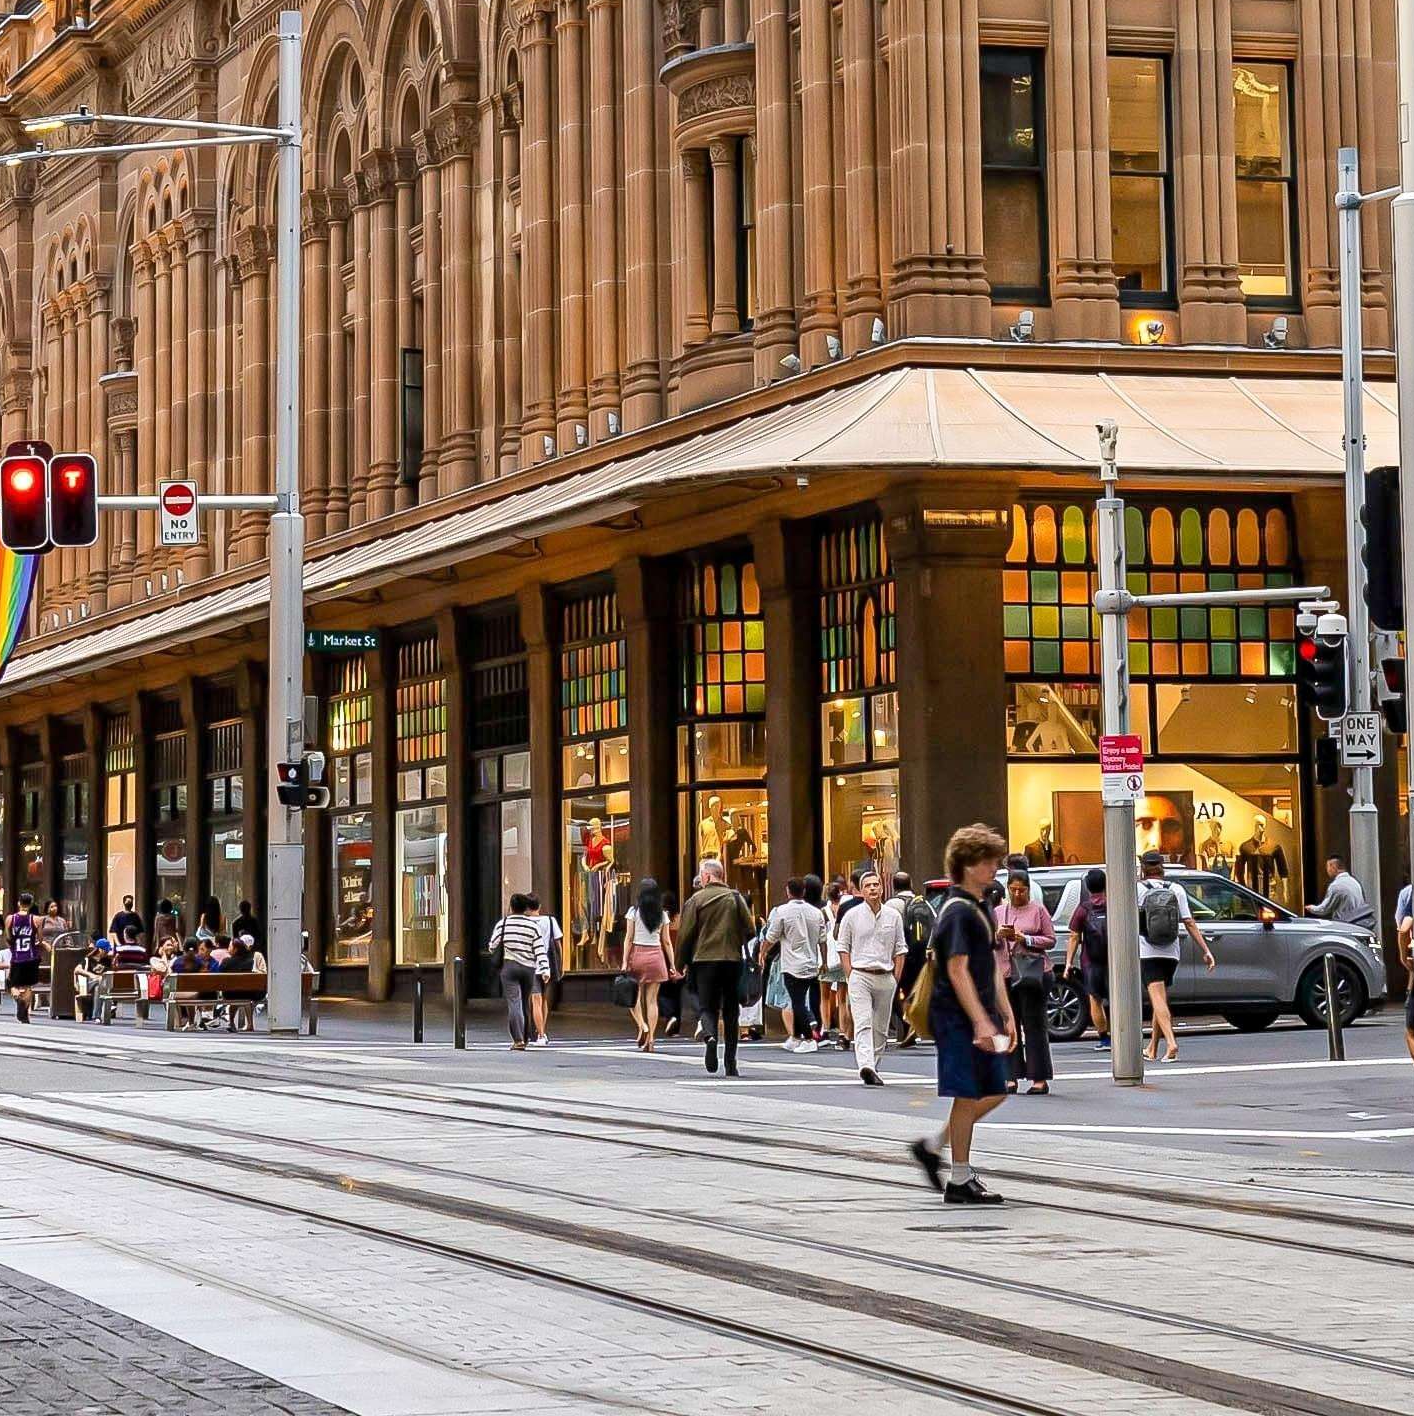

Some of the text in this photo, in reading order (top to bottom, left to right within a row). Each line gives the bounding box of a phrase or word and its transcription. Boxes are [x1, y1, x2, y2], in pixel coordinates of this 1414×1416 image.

[64, 471, 81, 488] T
[170, 519, 189, 529] NO
[164, 531, 195, 541] ENTRY
[323, 634, 376, 647] Market St
[1346, 717, 1375, 730] ONE
[1345, 733, 1377, 746] WAY
[15, 937, 31, 952] 15
